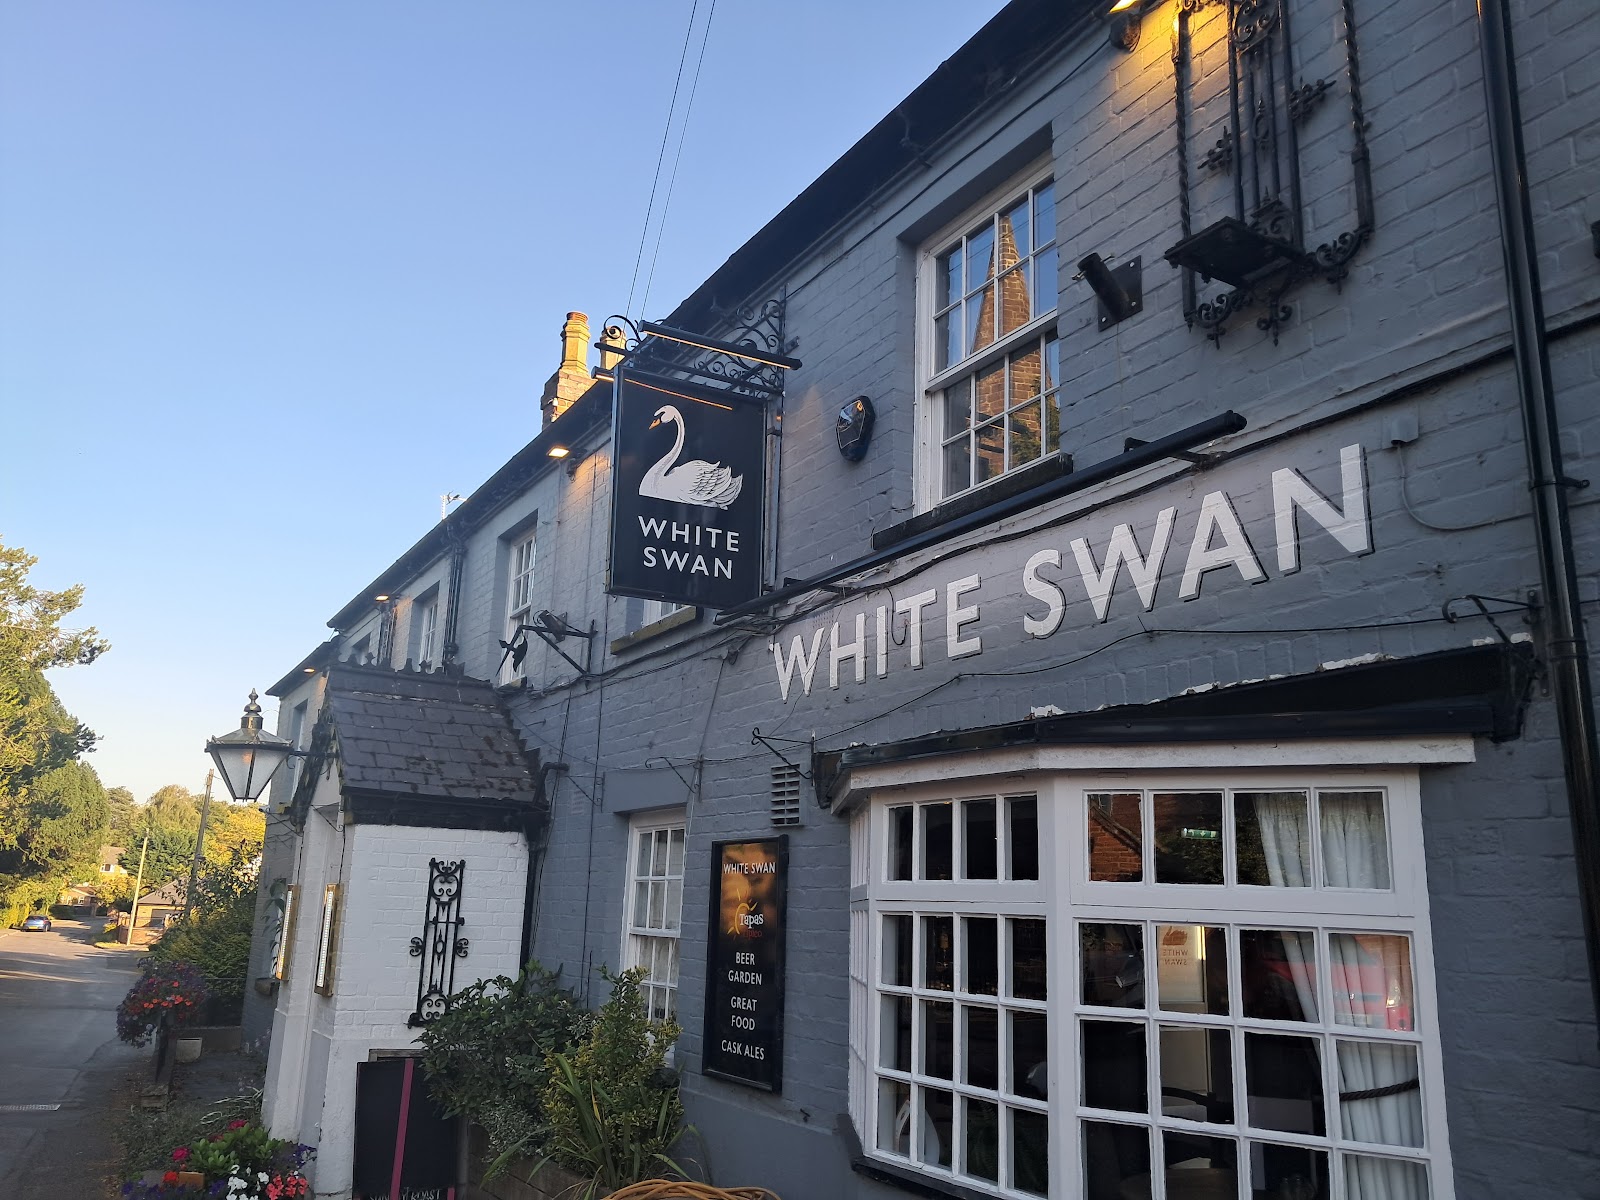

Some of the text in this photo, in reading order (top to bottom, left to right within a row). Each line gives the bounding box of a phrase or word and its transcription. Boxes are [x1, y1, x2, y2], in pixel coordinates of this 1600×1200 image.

[637, 515, 740, 553] WHITE
[643, 546, 733, 580] SWAN
[771, 443, 1373, 701] WHITE SWAN
[723, 861, 776, 875] WHITE SWAN
[739, 913, 764, 929] Tapas
[735, 952, 756, 966] BEER
[728, 969, 762, 986] GARDEN
[730, 996, 758, 1012] GREAT
[731, 1014, 756, 1031] FOOD
[721, 1039, 765, 1061] CASK ALES
